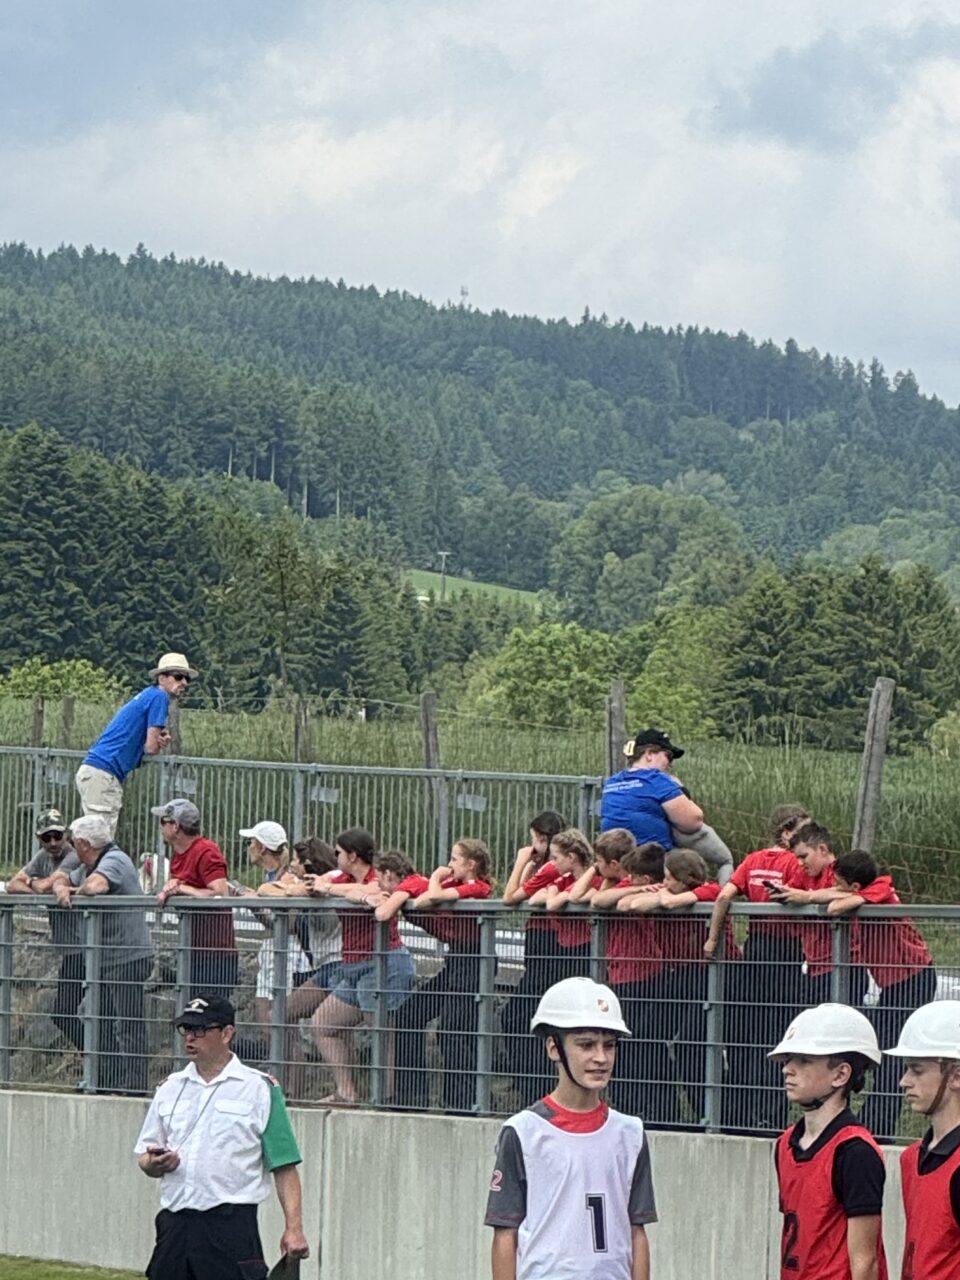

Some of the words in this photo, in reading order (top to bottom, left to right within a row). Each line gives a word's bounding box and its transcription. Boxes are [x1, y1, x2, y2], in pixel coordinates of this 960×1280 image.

[489, 1169, 503, 1192] 2
[585, 1193, 608, 1253] 1
[783, 1210, 800, 1272] 2
